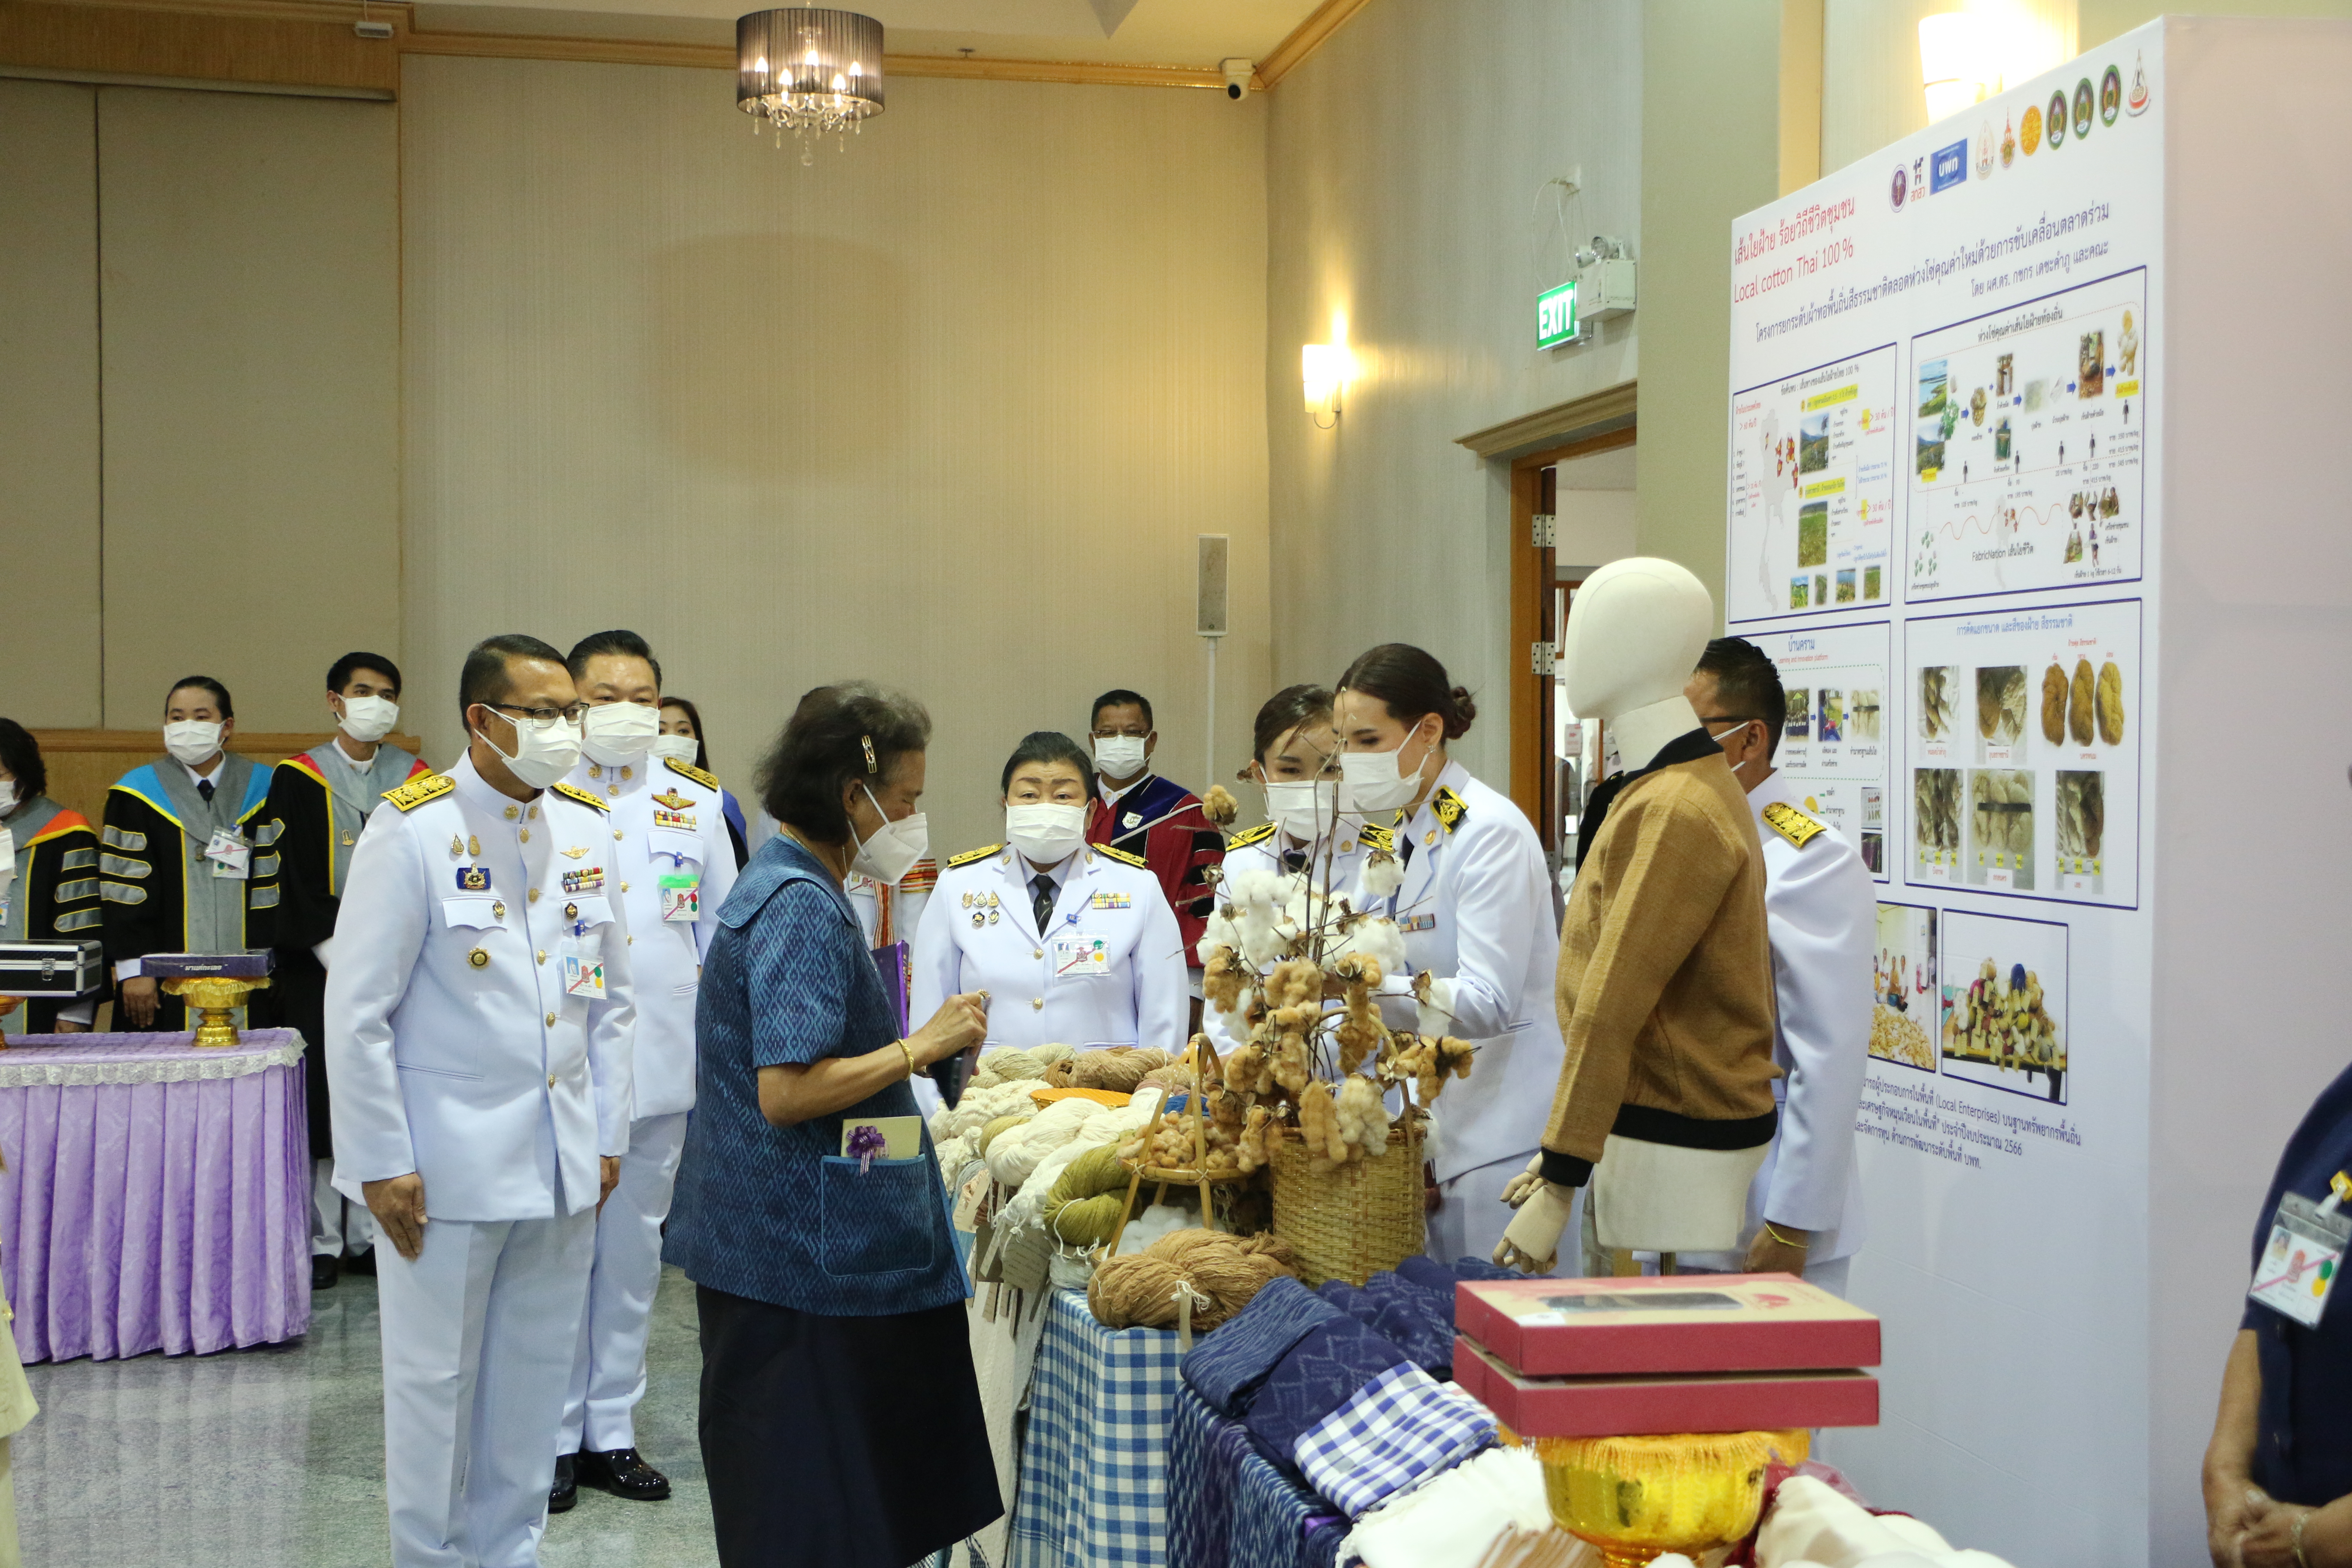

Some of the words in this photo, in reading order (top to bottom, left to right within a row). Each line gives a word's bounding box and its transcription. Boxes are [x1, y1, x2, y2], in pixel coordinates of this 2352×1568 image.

[1911, 186, 1925, 202] สกสว
[1735, 229, 1775, 265] เส้นใยฝ้าย
[1779, 197, 1854, 246] ร้อยวิถีชีวิตชุมชน
[1734, 275, 1758, 303] Local
[1761, 266, 1792, 293] cotton
[1797, 250, 1818, 278] Thai
[1822, 242, 1840, 268] 100
[1843, 236, 1853, 260] %
[1971, 279, 1984, 297] โดย
[1987, 274, 2010, 292] ผศ.ดร.
[2013, 266, 2033, 284] กชกร
[2036, 251, 2069, 277] เดชะคำภู
[2073, 241, 2108, 264] และคณะ
[1539, 289, 1574, 340] EXIT
[1978, 302, 2063, 342] ห่วงโซ่คุณค่าเส้นใยฝ้ายท้องถิ่น
[1972, 548, 2006, 561] FabricNation
[2008, 542, 2034, 557] เส้นใยชีวิต
[1788, 634, 1815, 652] บ้านคราม
[1957, 621, 1999, 636] การคัดแยกขนาด
[2001, 616, 2039, 632] และสีของฝ้าย
[2041, 613, 2073, 629] สีธรรมชาติ
[1936, 1094, 1956, 1112] (Local
[1959, 1101, 2000, 1125] Enterprises)
[2003, 1115, 2081, 1146] บนฐานทรัพยากรพื้นถิ่น
[1942, 1120, 2002, 1150] ประจำปีงบประมาณ
[2005, 1139, 2022, 1155] 2566
[1892, 1126, 1962, 1163] ด้านการพัฒนาระดับพื้นที่
[1964, 1154, 1981, 1169] บพท.
